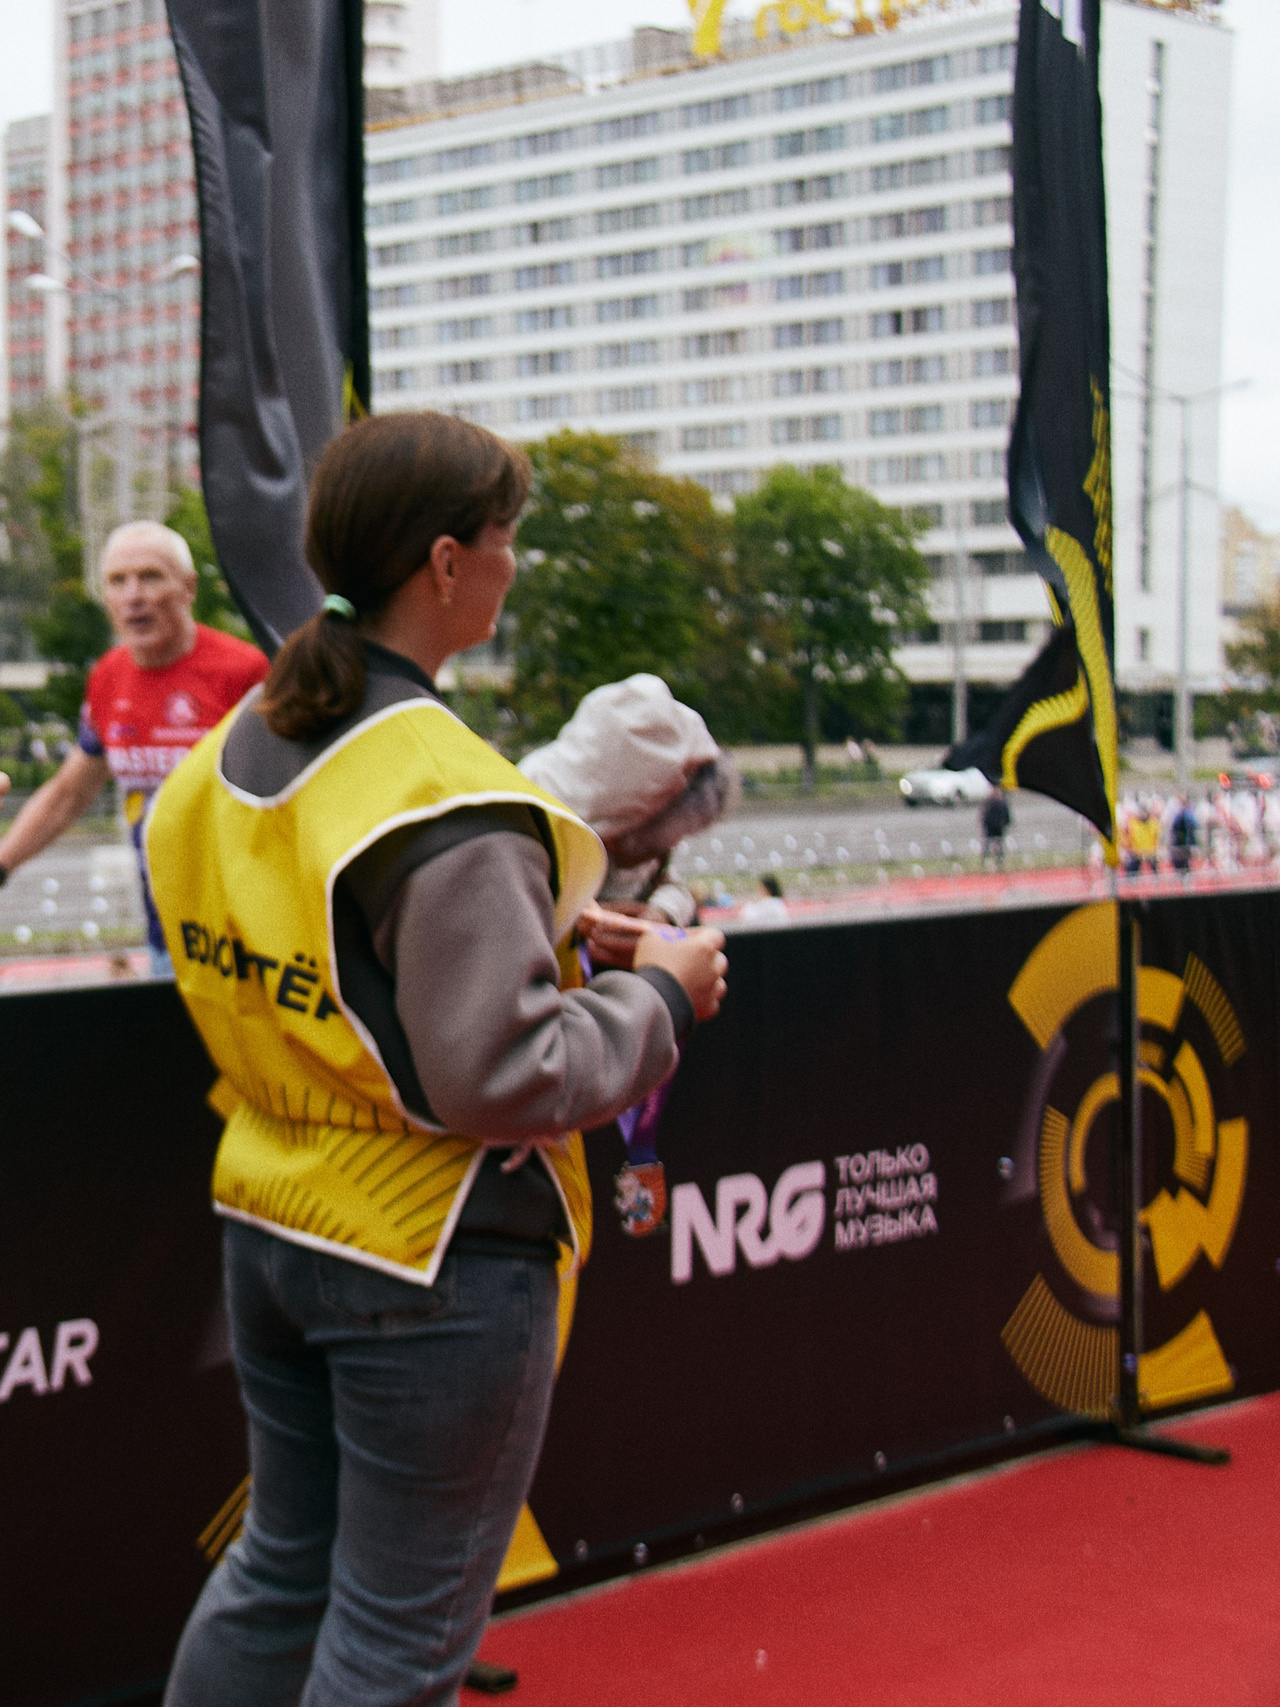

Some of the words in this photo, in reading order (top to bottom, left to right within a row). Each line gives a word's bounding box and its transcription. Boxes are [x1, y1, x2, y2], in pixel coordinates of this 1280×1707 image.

[834, 1142, 930, 1185] ТОЛЬКО
[834, 1172, 939, 1218] ЛУЧШАЯ
[670, 1159, 827, 1286] NRG
[834, 1204, 939, 1251] МУЗЫКА
